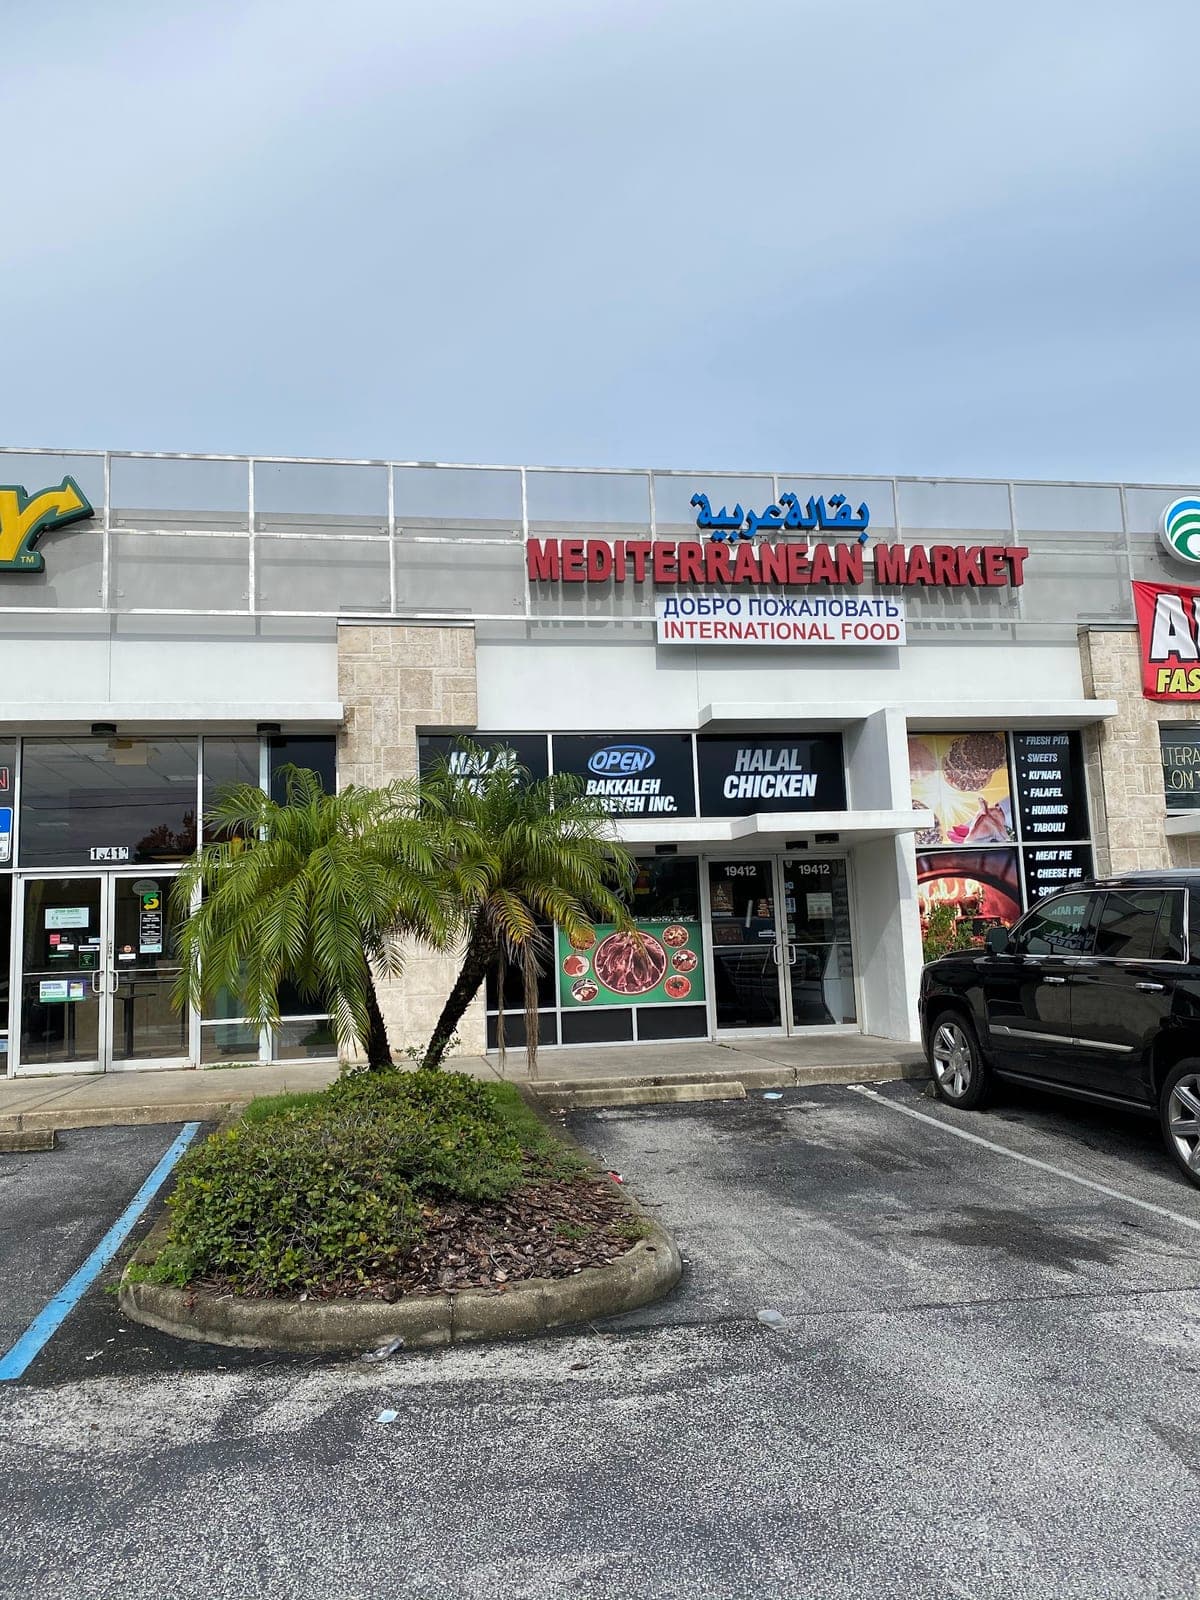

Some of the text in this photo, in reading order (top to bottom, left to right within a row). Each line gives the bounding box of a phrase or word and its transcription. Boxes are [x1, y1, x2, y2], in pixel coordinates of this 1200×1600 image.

[690, 492, 870, 544] بقالة عربية
[21, 556, 34, 564] TM
[526, 538, 1029, 587] MEDITERRANEAN MARKET
[663, 597, 899, 618] ДОБРО ПОЖАЛОВАТЬ
[663, 621, 900, 641] INTERNATIONAL FOOD
[1149, 593, 1200, 663] A
[1026, 735, 1070, 746] FRESH PITA
[592, 750, 648, 772] OPEN
[734, 749, 802, 772] HALAL
[1027, 753, 1058, 763] SWEETS
[1028, 770, 1062, 780] KU'NAFA
[585, 778, 662, 796] BAKKALEH
[723, 774, 818, 799] CHICKEN
[1029, 787, 1063, 797] FALAFEL
[647, 795, 678, 812] INC.
[1031, 805, 1069, 815] HUMMUS
[1033, 822, 1066, 832] TABOULI
[1035, 850, 1073, 860] MEAT PIE
[724, 865, 757, 877] 19412
[798, 864, 831, 875] 19412
[1037, 867, 1083, 878] CHEESE PIE
